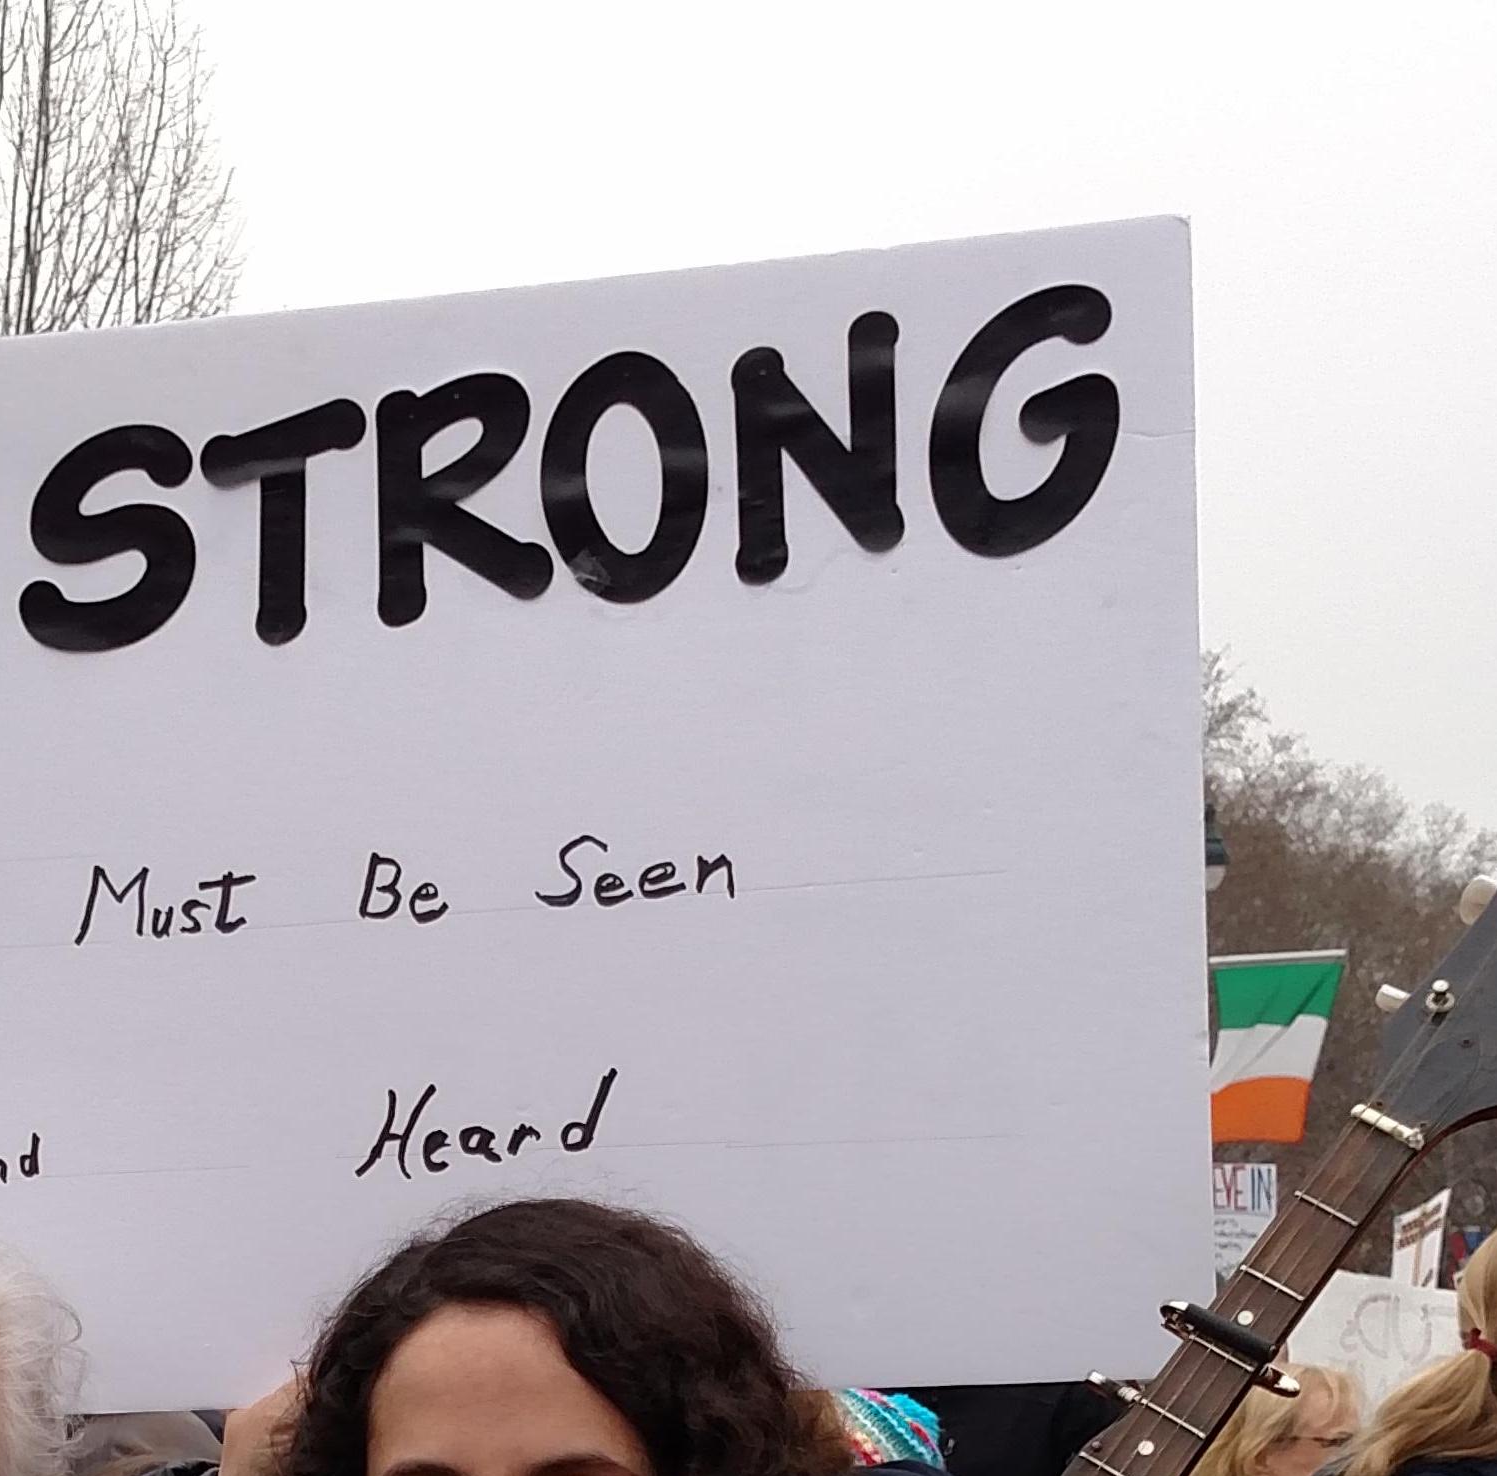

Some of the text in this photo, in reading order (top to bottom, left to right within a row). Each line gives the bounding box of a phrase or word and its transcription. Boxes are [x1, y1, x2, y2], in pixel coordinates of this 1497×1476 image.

[16, 284, 1121, 653] STRONG
[74, 865, 257, 946] Must
[358, 852, 449, 924] Be
[534, 834, 736, 907] Seen
[354, 1067, 619, 1180] Heard
[1250, 1167, 1273, 1212] IN
